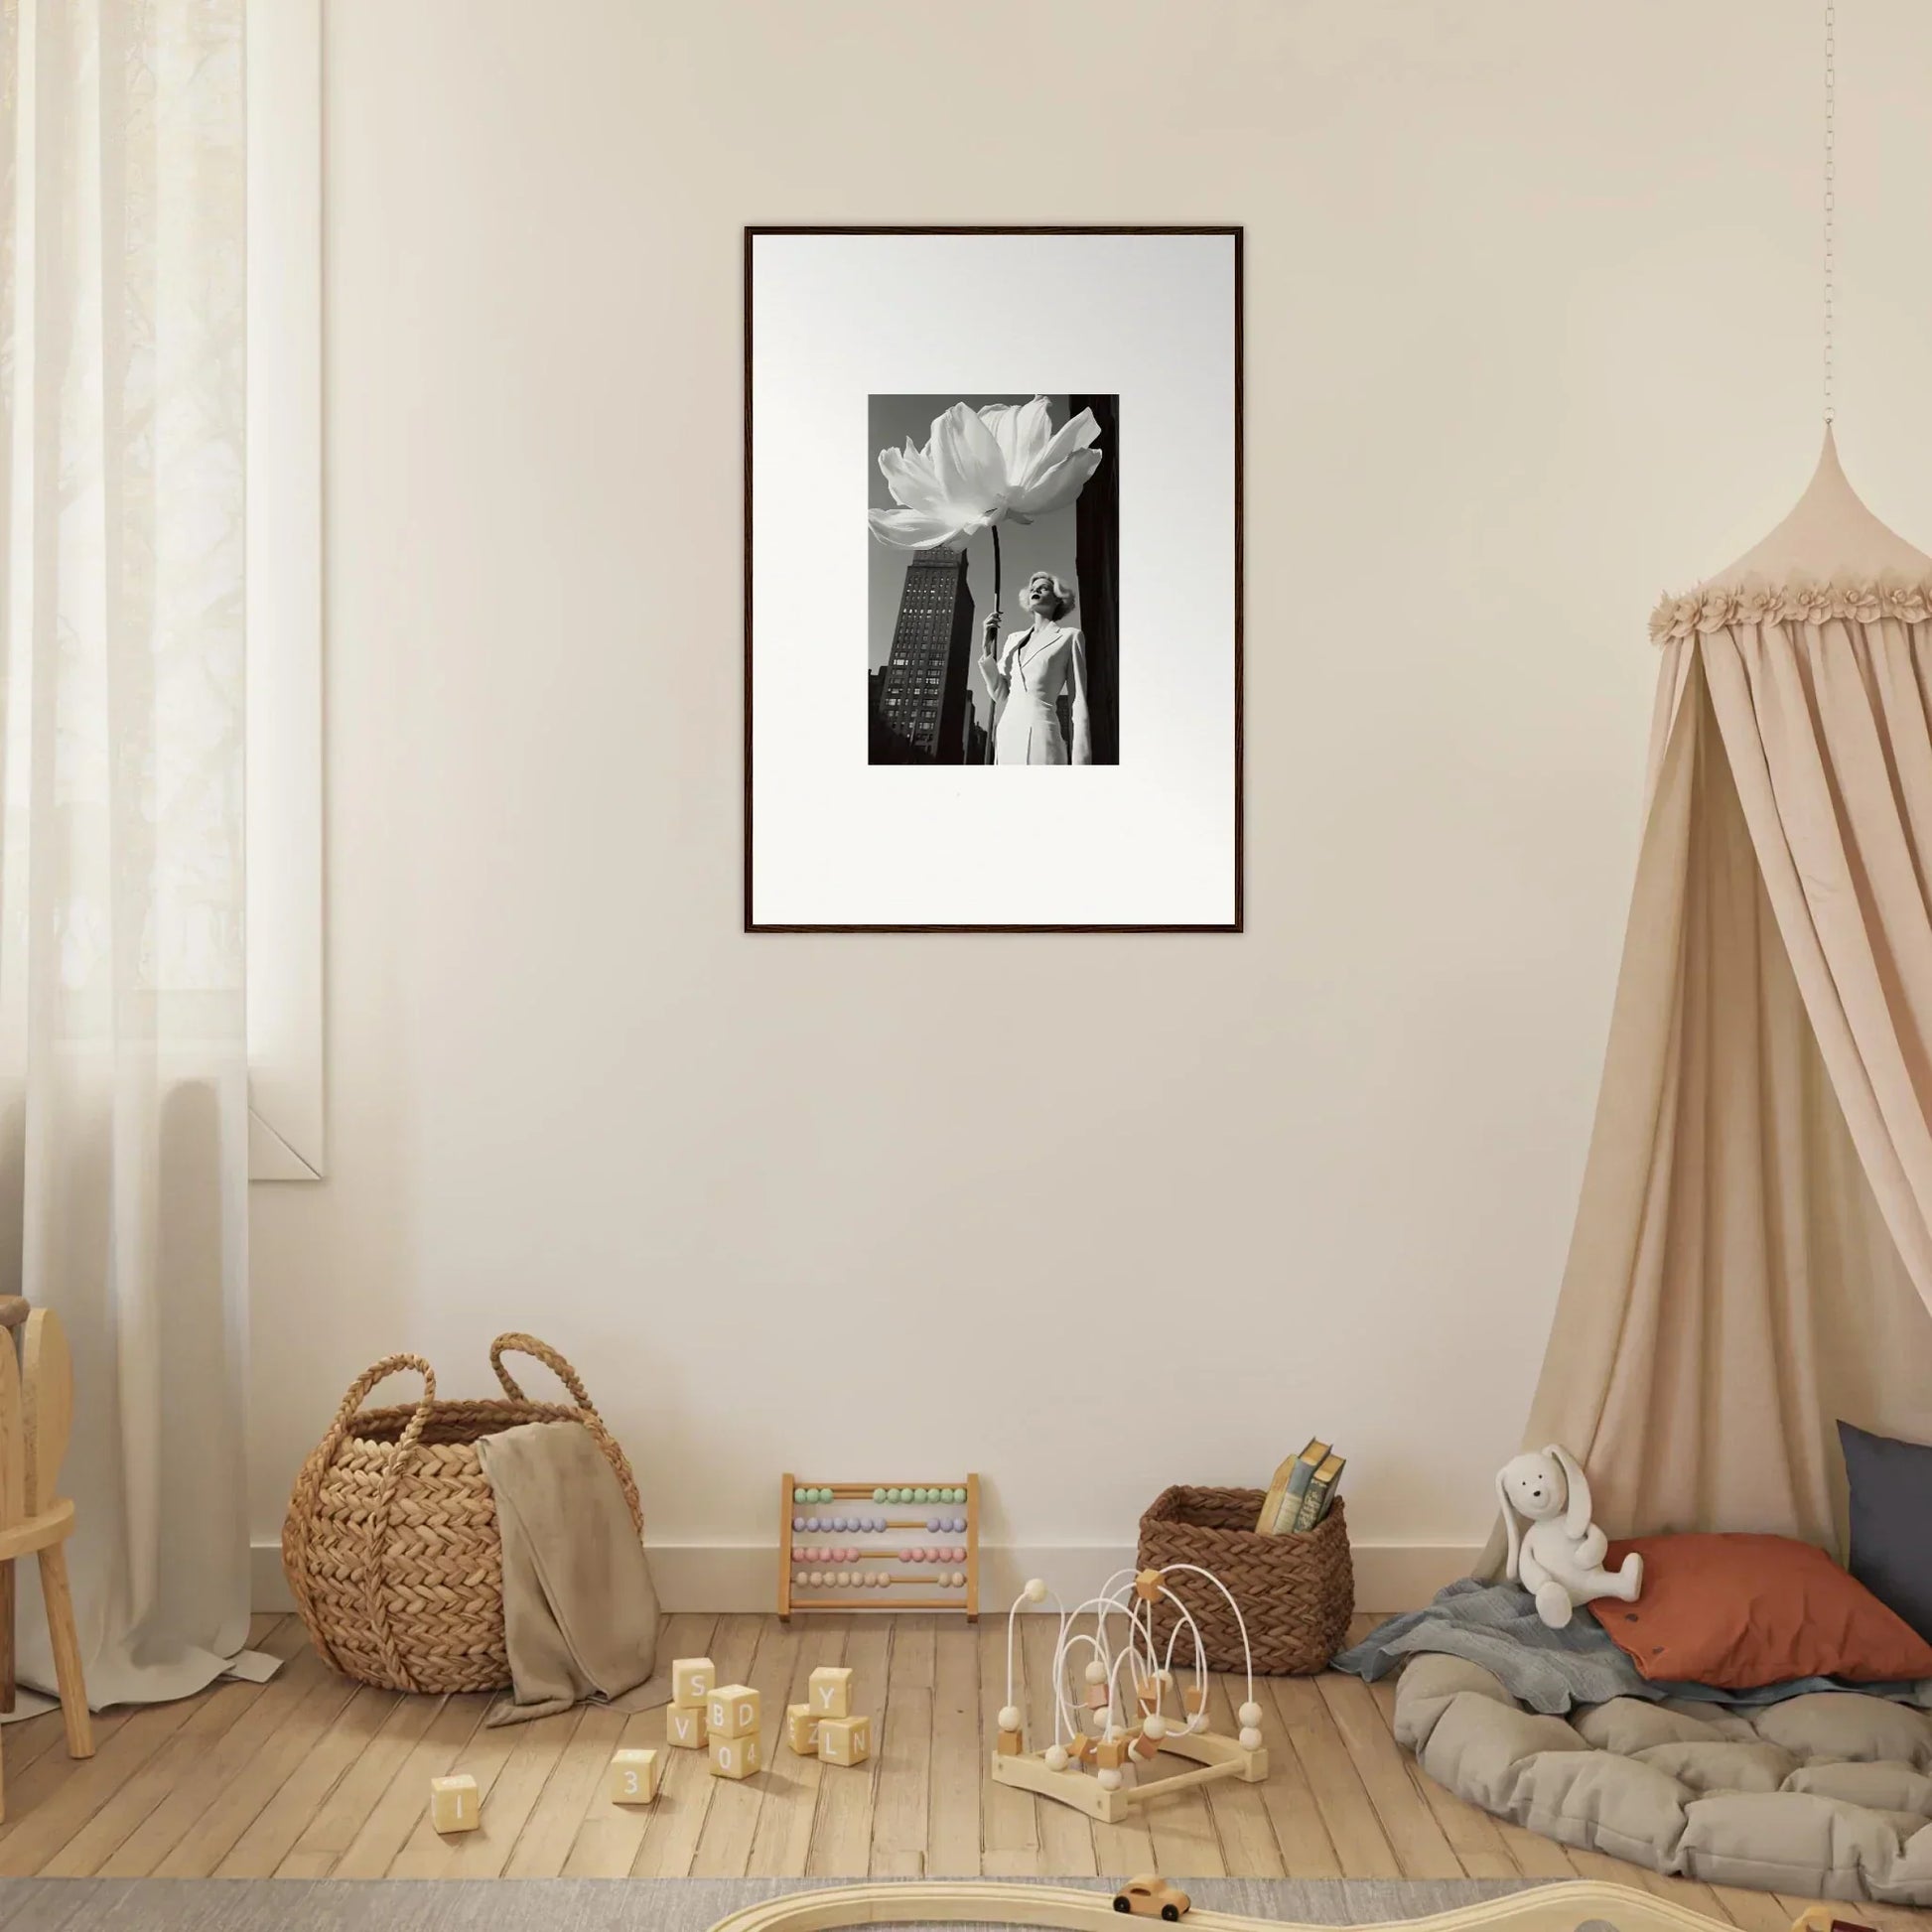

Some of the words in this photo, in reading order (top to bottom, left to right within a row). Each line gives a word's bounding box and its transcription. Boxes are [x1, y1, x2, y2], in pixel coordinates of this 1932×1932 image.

[691, 1675, 706, 1697] S
[818, 1687, 835, 1709] Y
[713, 1703, 725, 1726] B
[739, 1703, 754, 1726] D
[674, 1717, 690, 1739] V
[825, 1731, 838, 1755] L
[854, 1729, 866, 1753] N
[623, 1770, 637, 1795] 3
